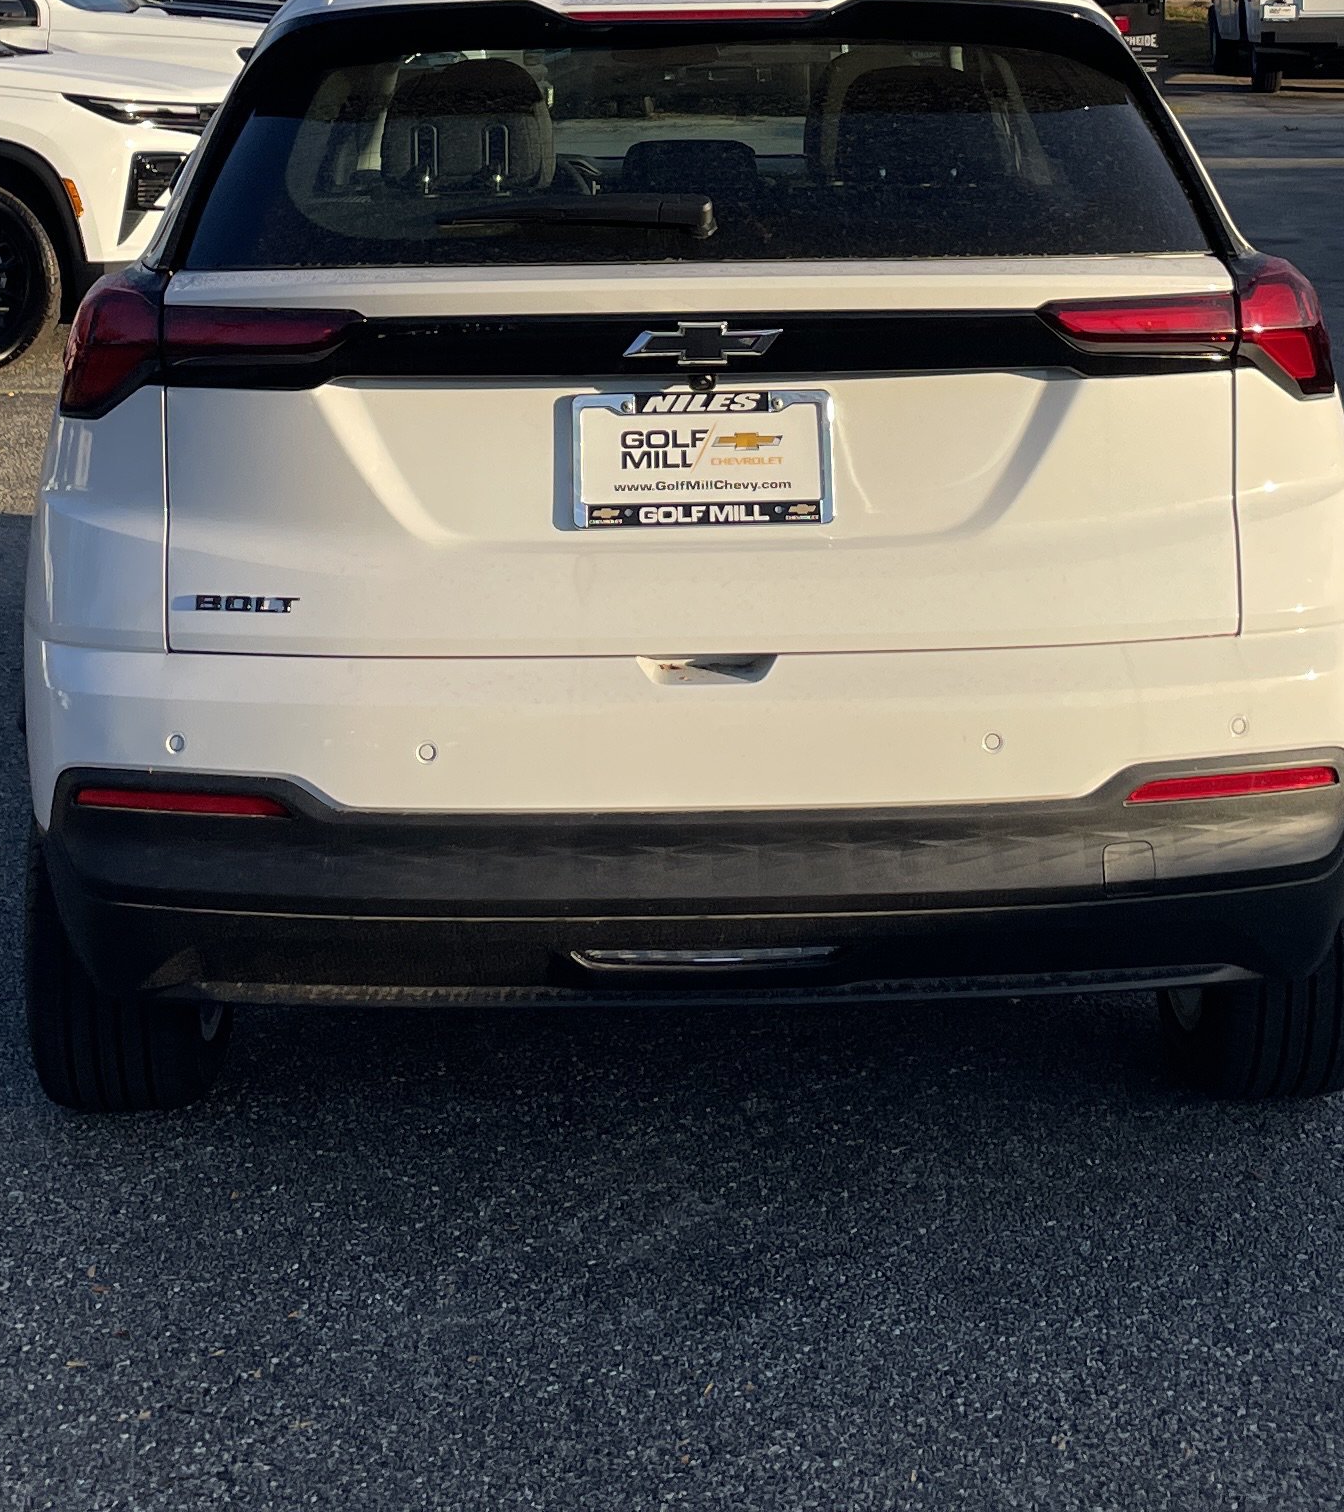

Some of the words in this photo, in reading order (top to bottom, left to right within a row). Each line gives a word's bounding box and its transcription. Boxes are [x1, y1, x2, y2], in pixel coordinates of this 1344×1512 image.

[642, 392, 762, 413] NILES
[621, 429, 709, 449] GOLF
[621, 450, 693, 470] MILL
[710, 455, 785, 466] CHEVROLET
[613, 479, 792, 492] www.GolfMillChevy.com
[639, 505, 707, 524] GOLF
[709, 504, 770, 523] MILL
[196, 594, 301, 614] BOLT
